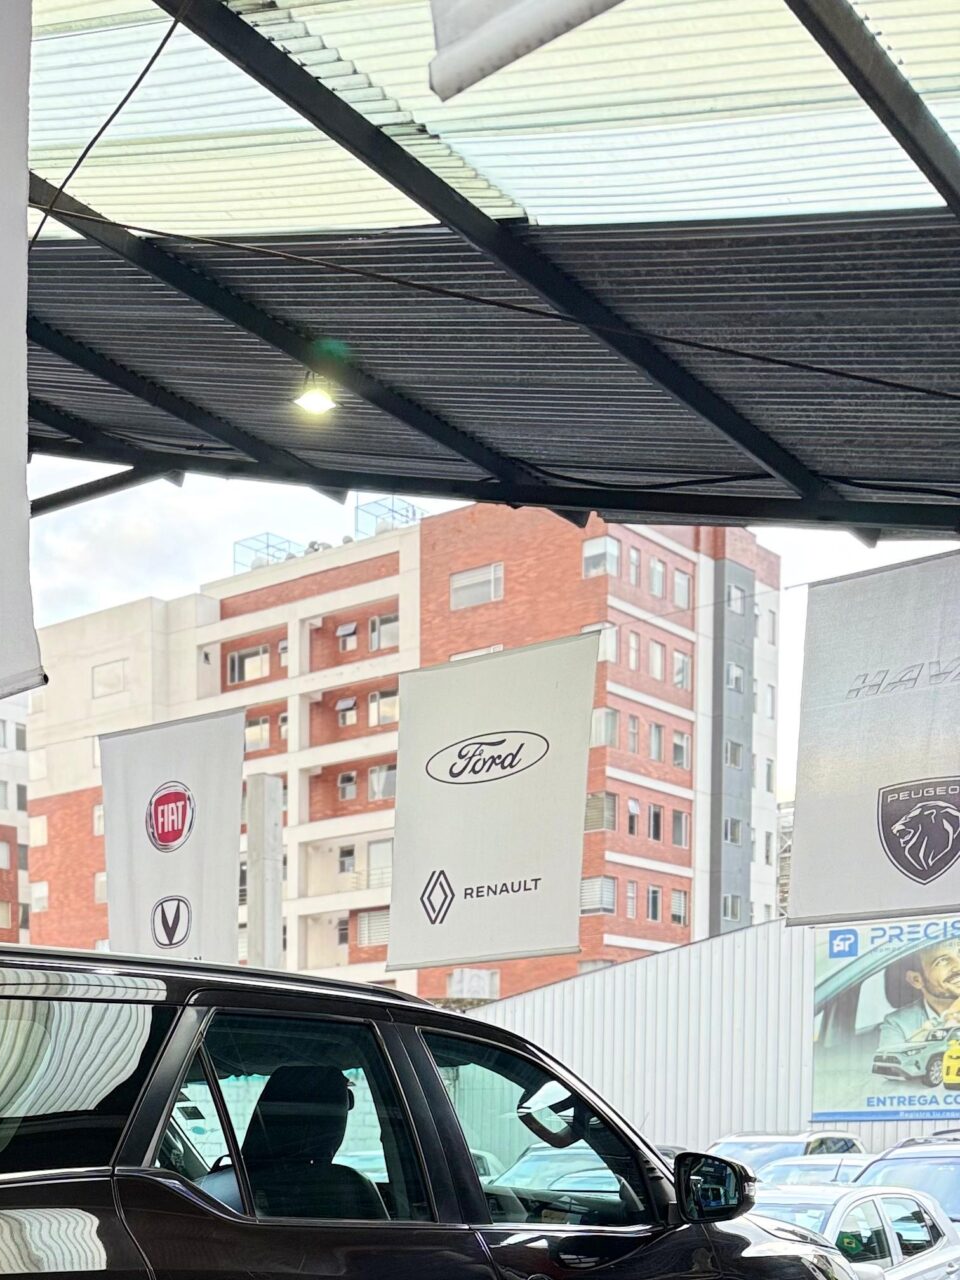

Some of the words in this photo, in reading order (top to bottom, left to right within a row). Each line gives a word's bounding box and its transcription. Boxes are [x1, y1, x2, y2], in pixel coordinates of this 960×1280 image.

[448, 738, 524, 782] Ford
[887, 785, 960, 803] PEUGEO
[157, 800, 185, 834] FIAT
[463, 877, 543, 901] RENAULT
[866, 1094, 940, 1107] ENTREGA
